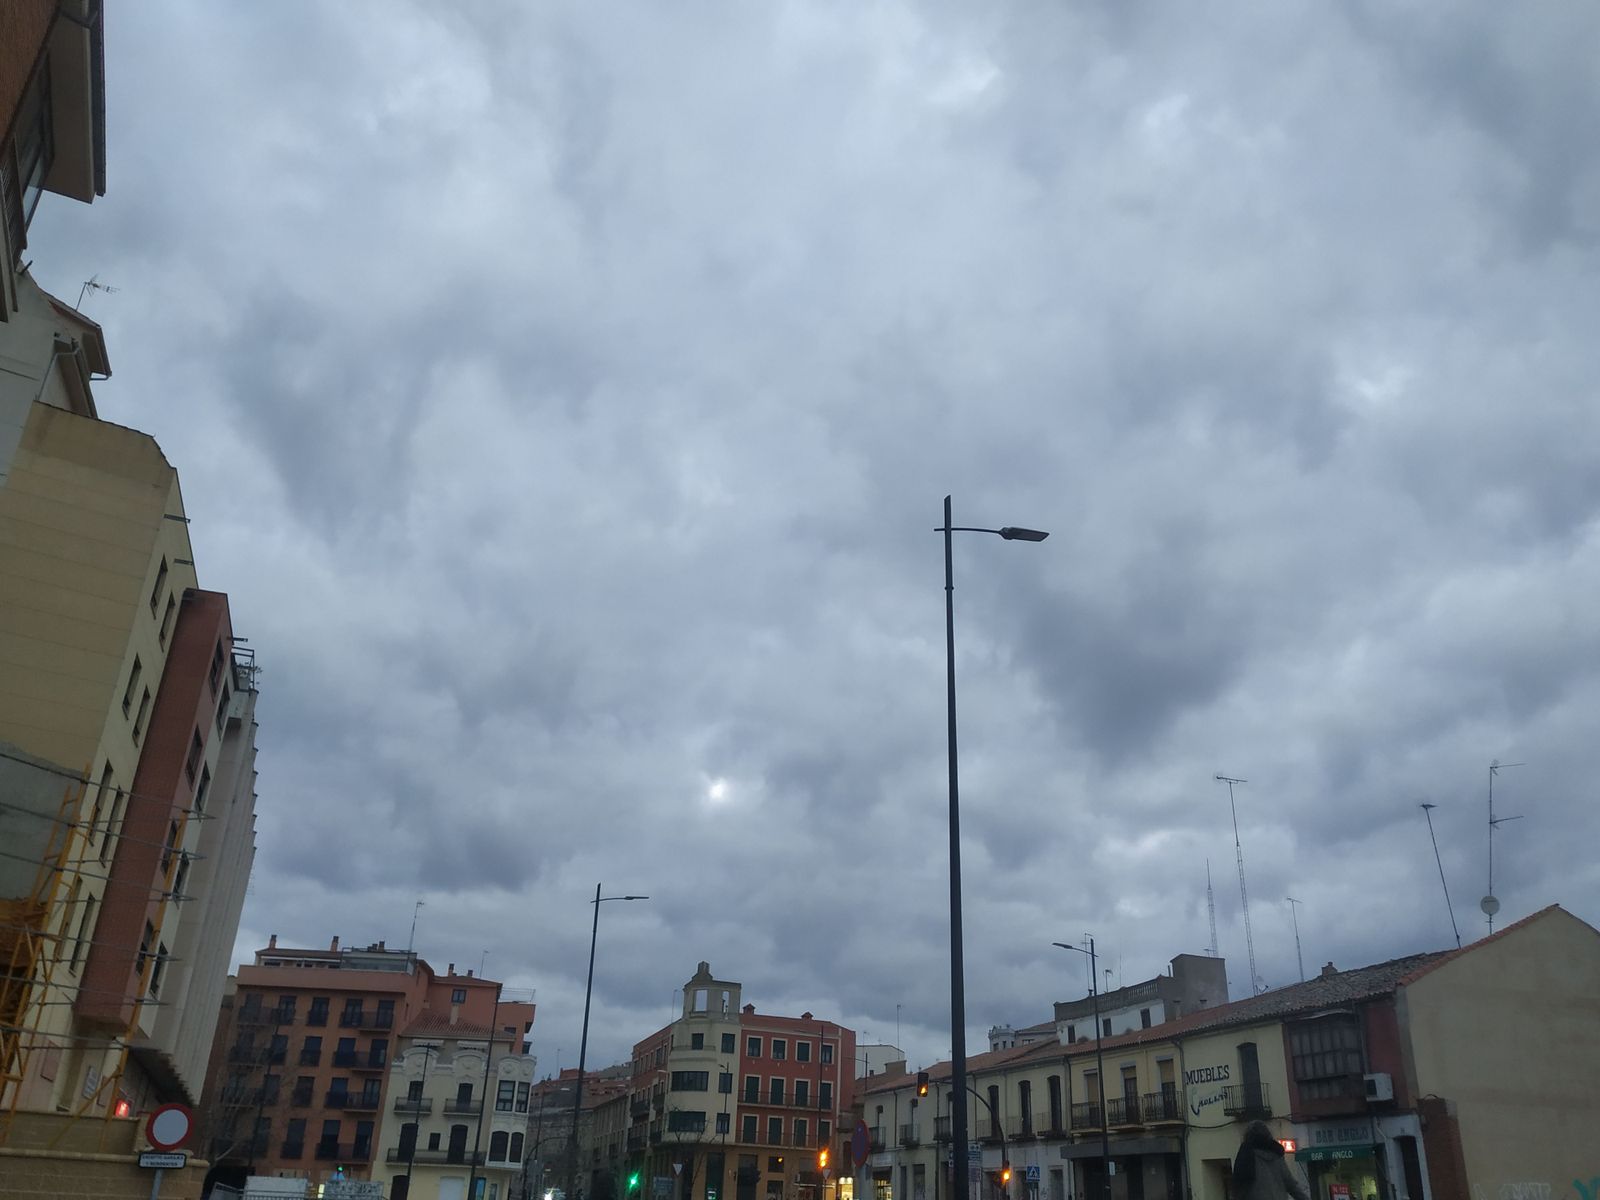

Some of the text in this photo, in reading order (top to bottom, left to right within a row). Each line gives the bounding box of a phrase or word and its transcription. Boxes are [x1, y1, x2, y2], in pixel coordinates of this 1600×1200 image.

[1185, 1064, 1230, 1085] MUEBLES
[1315, 1127, 1369, 1144] BAR ANGLO
[1311, 1150, 1353, 1160] BAR ANGLO
